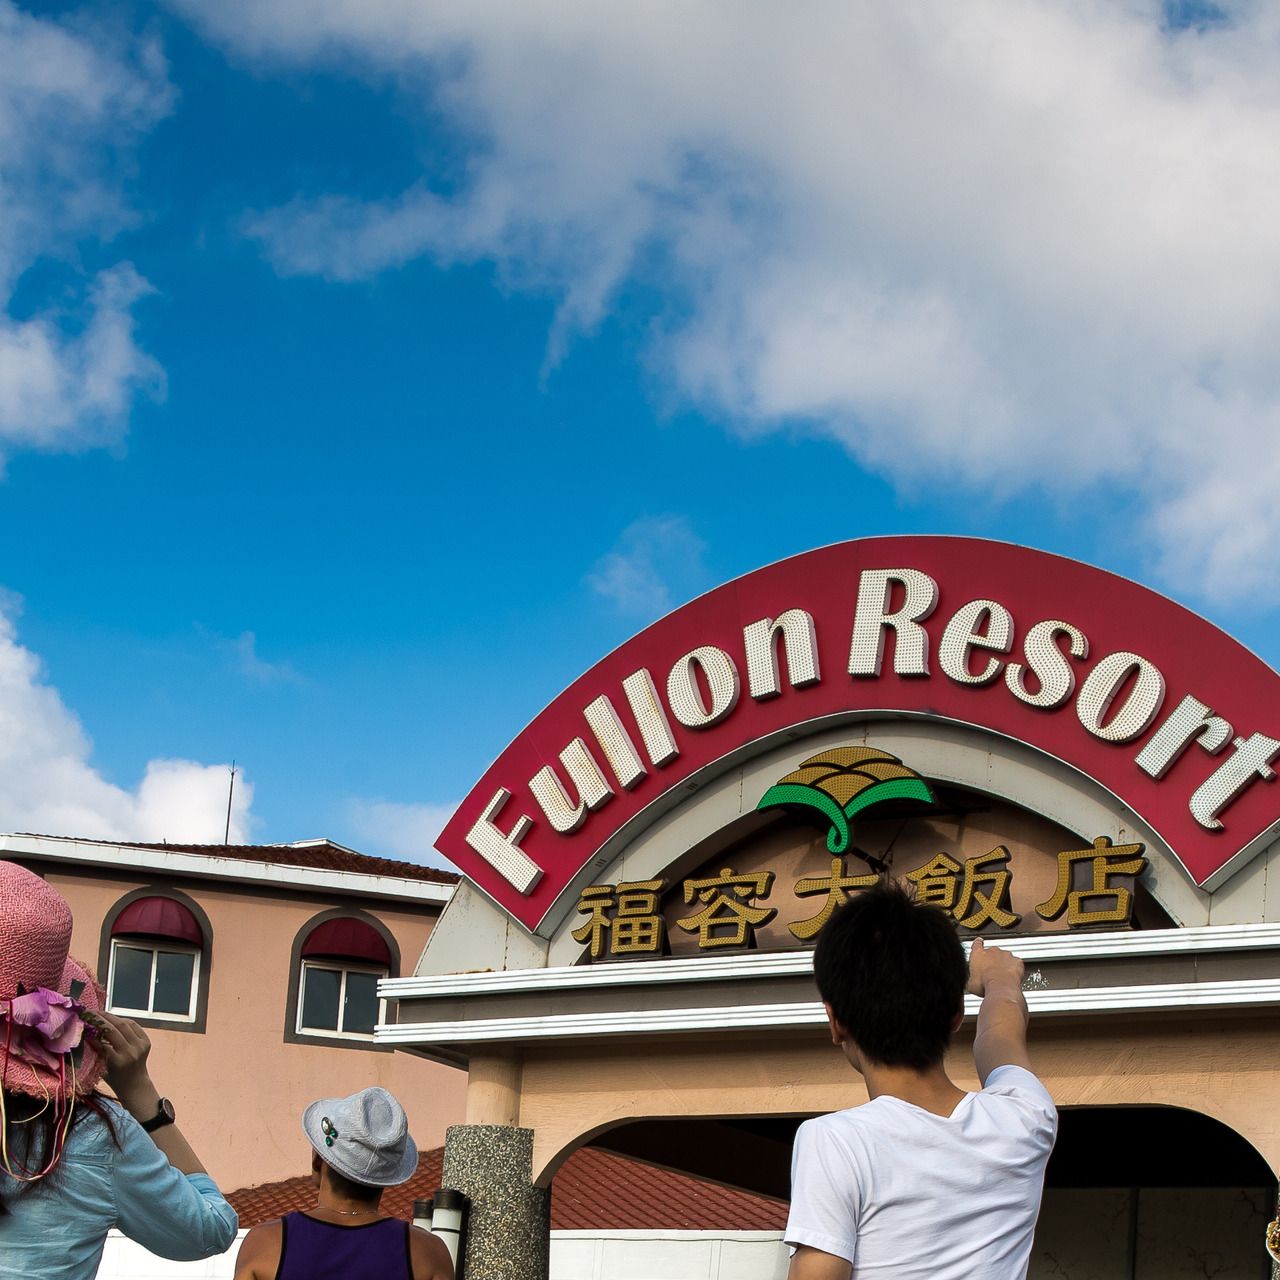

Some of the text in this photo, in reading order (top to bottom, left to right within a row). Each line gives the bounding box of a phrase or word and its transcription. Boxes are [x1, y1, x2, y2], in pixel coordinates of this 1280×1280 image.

[464, 607, 822, 896] Fullon
[572, 836, 1146, 961] 福容大飯店
